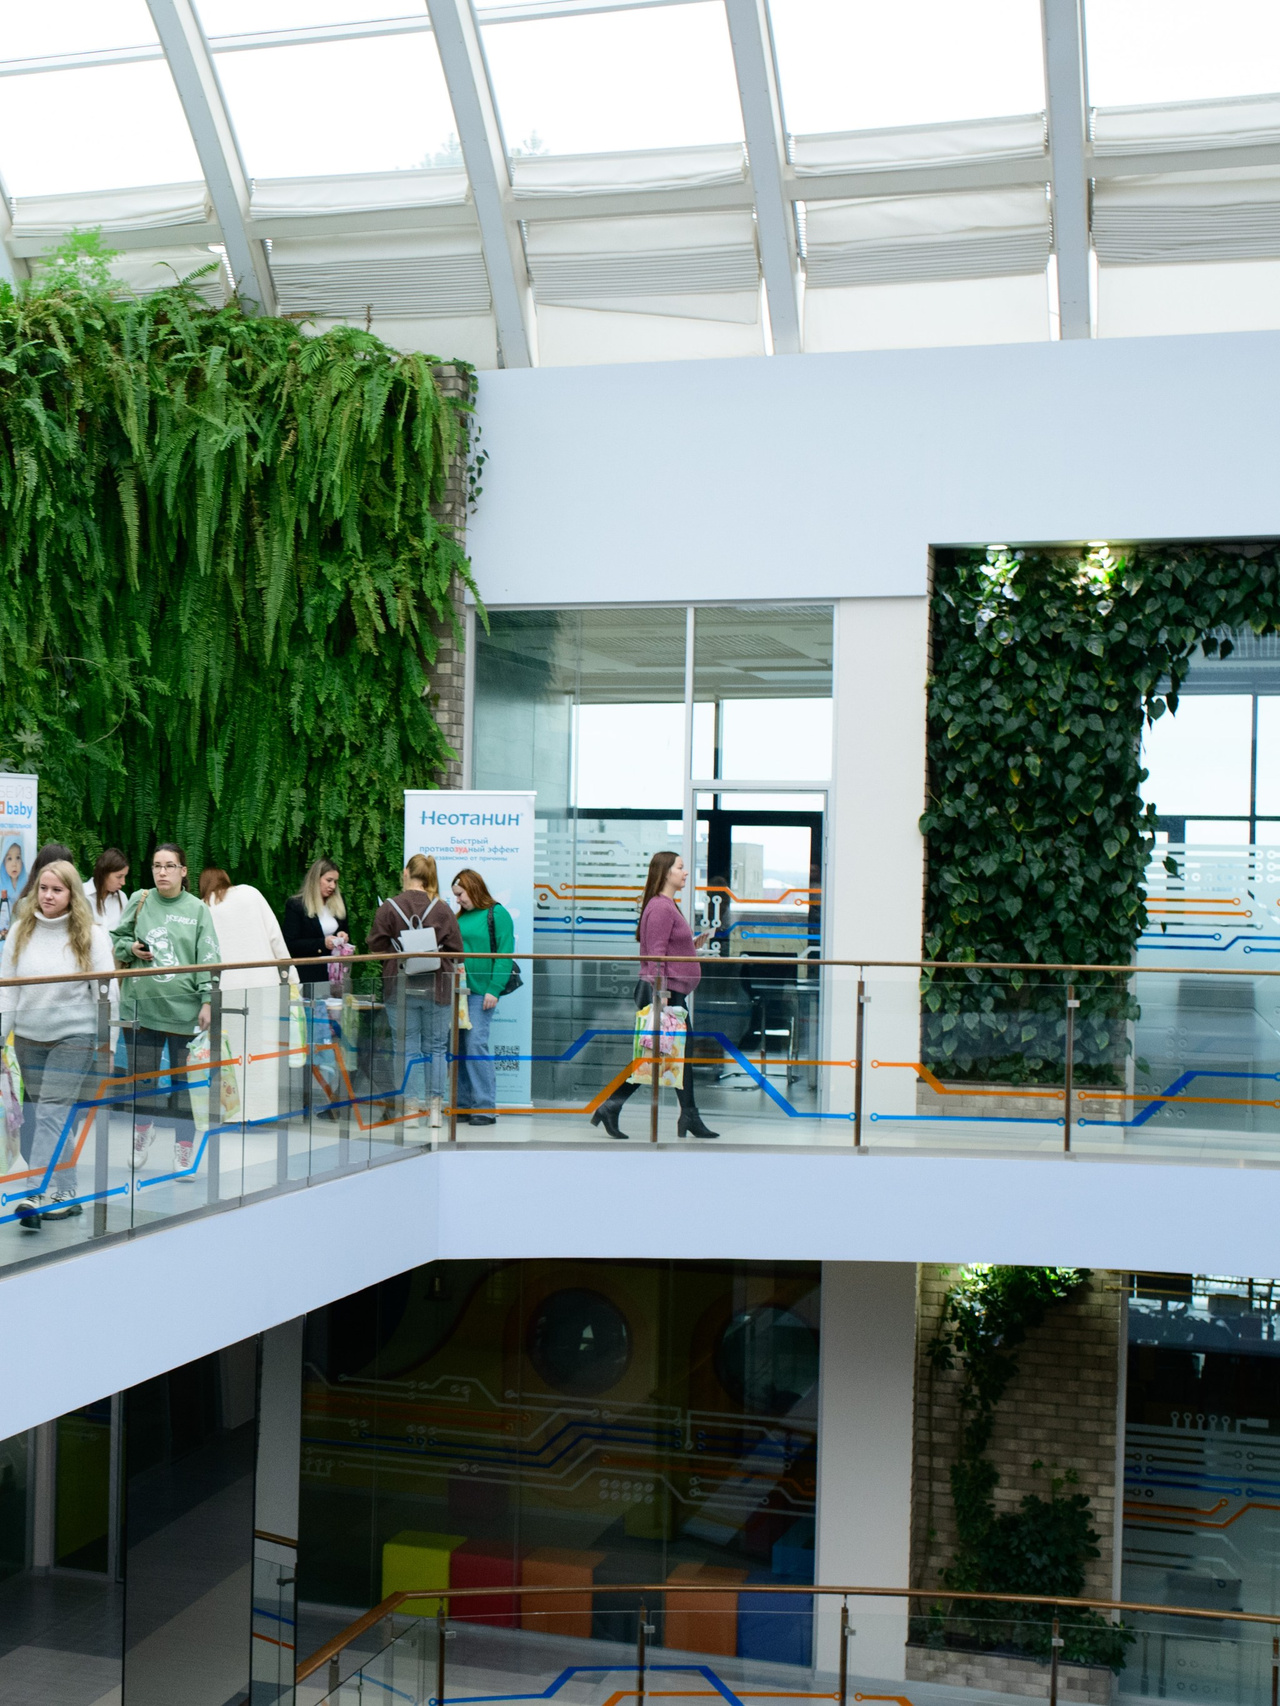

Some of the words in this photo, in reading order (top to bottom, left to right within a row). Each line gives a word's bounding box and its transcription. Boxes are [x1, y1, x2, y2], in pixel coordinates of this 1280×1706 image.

[6, 801, 33, 819] baby
[420, 810, 519, 826] Неотанин
[450, 836, 488, 846] Быстрый
[419, 846, 485, 854] противозудный
[487, 846, 519, 854] эффект
